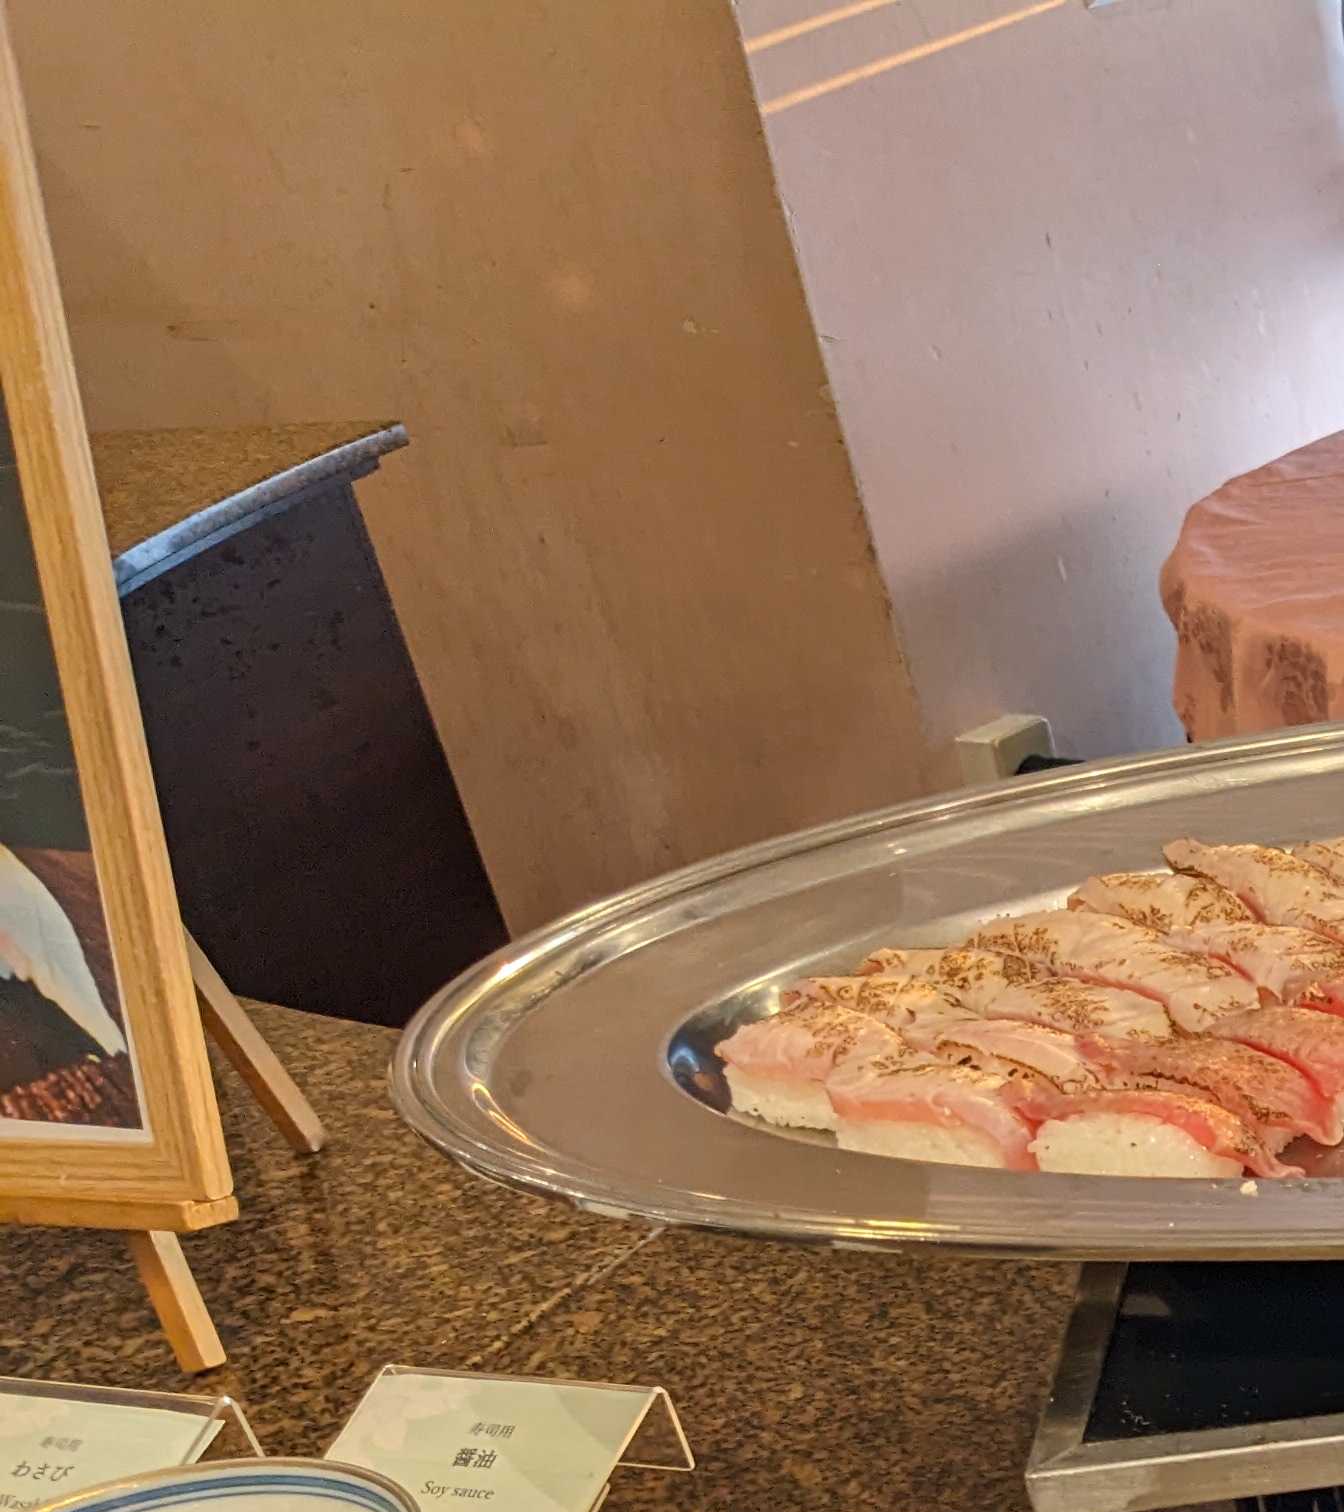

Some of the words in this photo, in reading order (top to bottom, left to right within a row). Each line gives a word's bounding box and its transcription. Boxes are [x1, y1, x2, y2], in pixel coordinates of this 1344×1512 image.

[470, 1422, 516, 1438] 寿司用
[11, 1460, 75, 1482] わさび
[420, 1481, 449, 1499] Soy
[451, 1485, 495, 1500] sauce
